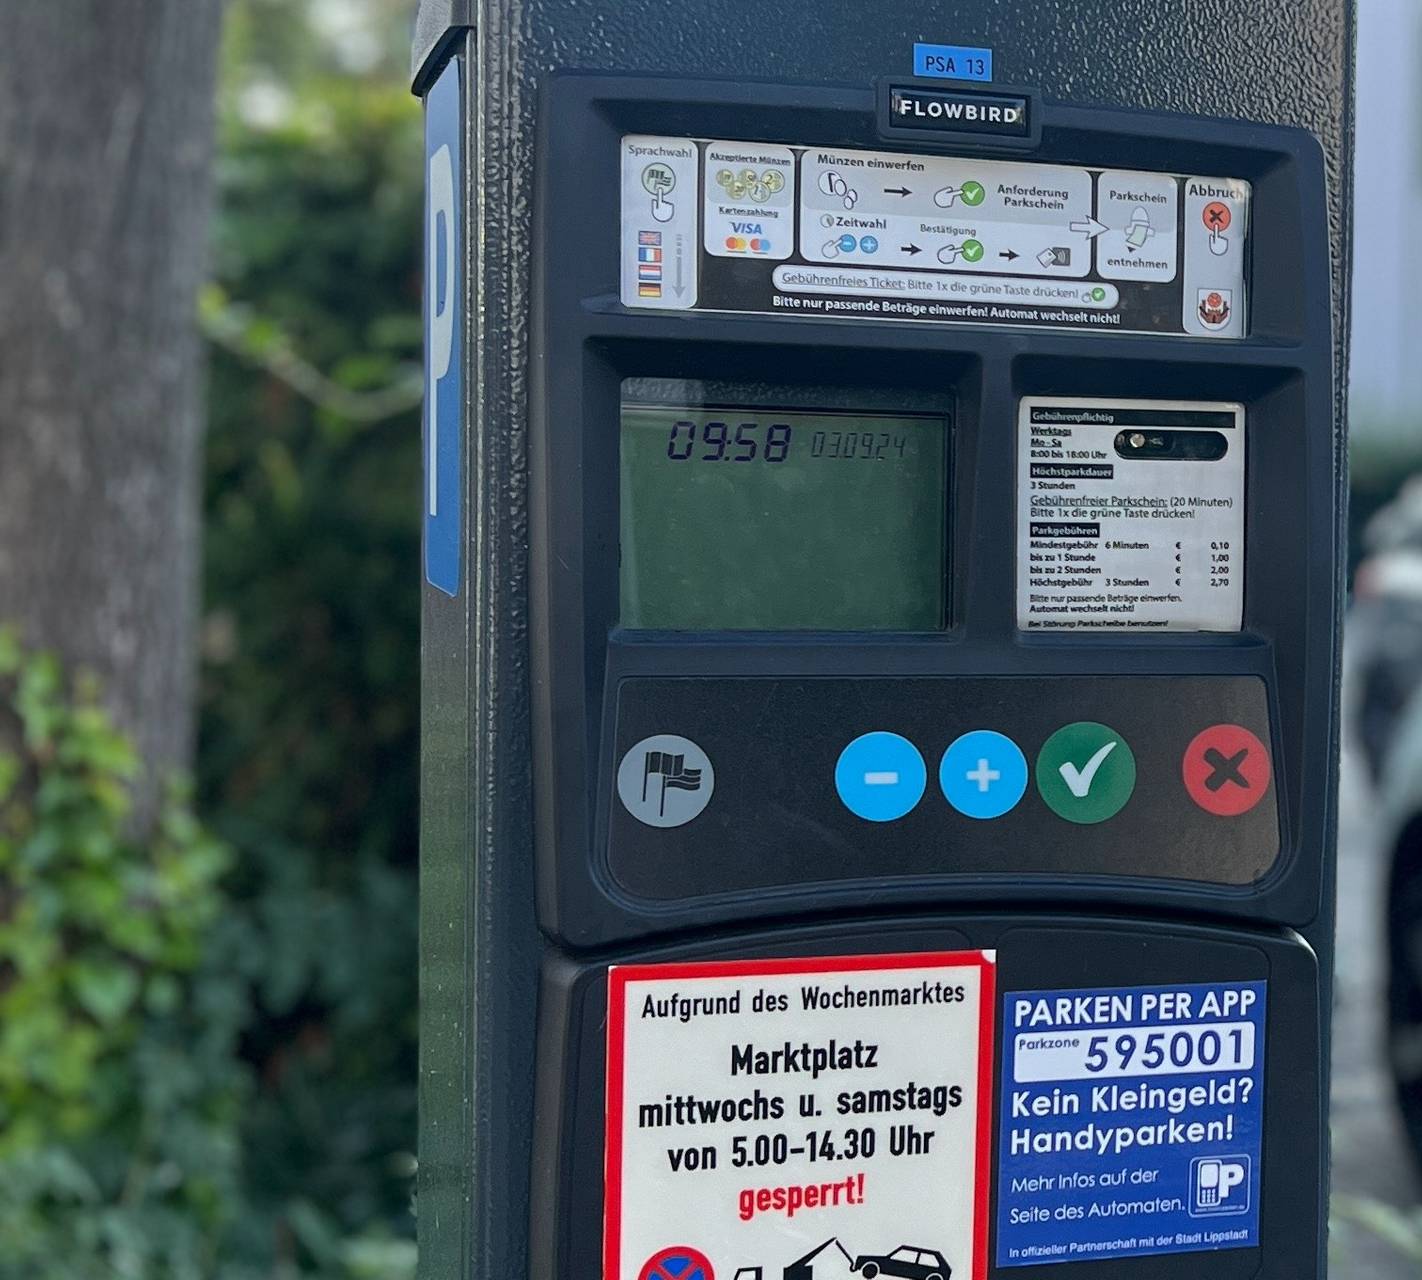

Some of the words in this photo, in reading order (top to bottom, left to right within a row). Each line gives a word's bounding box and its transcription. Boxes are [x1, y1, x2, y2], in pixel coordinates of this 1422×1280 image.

[925, 55, 955, 73] PSA
[966, 59, 984, 76] 13
[901, 99, 1018, 123] FLOWBIRD
[628, 144, 692, 159] Sprachwahl
[709, 152, 757, 164] Akzeptierte
[758, 156, 791, 166] Münzen
[817, 154, 864, 168] Münzen
[867, 158, 925, 172] einwerfen
[997, 184, 1069, 200] Anforderung
[1109, 190, 1167, 204] Parkschein
[1189, 184, 1244, 199] Abbruch
[1004, 196, 1065, 210] Parkschein
[718, 206, 779, 218] Kartenzahlung
[729, 221, 763, 235] VISA
[836, 216, 887, 230] Zeitwahl
[920, 223, 977, 237] Bestätigung
[1107, 258, 1168, 270] entnehmen
[782, 272, 868, 288] Gebührenfreies
[907, 279, 933, 291] Bitte
[936, 281, 948, 292] 1x
[950, 282, 968, 293] die
[969, 283, 1001, 296] grüne
[1003, 285, 1031, 296] Taste
[1032, 287, 1079, 299] drücken!
[773, 295, 801, 308] Bitte
[802, 298, 823, 309] nur
[825, 300, 880, 312] passende
[882, 302, 926, 316] Beträge
[928, 305, 988, 317] einwerfen!
[990, 307, 1039, 320] Automat
[1040, 310, 1088, 323] wechselt
[1090, 312, 1121, 325] nicht!
[430, 144, 454, 517] P
[1032, 410, 1114, 424] Gebührenpflichtig
[667, 420, 792, 462] 09:58
[1030, 438, 1045, 447] Mo
[1051, 439, 1062, 448] Sa
[1030, 449, 1050, 459] 8:00
[1051, 449, 1064, 459] bis
[1066, 450, 1090, 460] 18:00
[1090, 450, 1107, 460] Uhr
[1031, 466, 1113, 478] Höchstparkdauer
[1030, 482, 1036, 490] 3
[1038, 481, 1076, 491] Stunden
[1030, 495, 1109, 507] Gebührenfreier
[1110, 495, 1168, 508] Parkschein:
[1169, 497, 1187, 508] (20
[1188, 496, 1233, 508] Minuten)
[1030, 507, 1054, 518] Bitte
[1057, 508, 1069, 518] 1x
[1071, 508, 1088, 518] die
[1090, 508, 1121, 520] grüne
[1123, 508, 1150, 519] Taste
[1151, 508, 1195, 519] drücken!
[1031, 525, 1098, 536] Parkgebühren
[1030, 540, 1098, 551] Mindestgebühr
[1105, 541, 1111, 550] 6
[1112, 541, 1150, 550] Minuten
[1210, 541, 1230, 551] 0,10
[1030, 553, 1043, 562] bis
[1063, 553, 1096, 562] Stunde
[1030, 565, 1043, 575] bis
[1044, 567, 1056, 575] zu
[1057, 566, 1063, 574] 2
[1064, 565, 1101, 575] Stunden
[1030, 578, 1093, 589] Höchstgebühr
[1105, 579, 1111, 587] 3
[1112, 578, 1150, 587] Stunden
[1030, 594, 1050, 603] Bitte
[1066, 595, 1106, 605] passende
[1107, 594, 1139, 605] Beträge
[1029, 604, 1069, 613] Automat
[1070, 604, 1108, 613] wechselt
[1109, 604, 1135, 613] nicht!
[641, 990, 741, 1023] Aufgrund
[752, 988, 789, 1013] des
[801, 981, 965, 1011] Wochenmarktes
[1014, 995, 1132, 1027] PARKEN
[1141, 992, 1192, 1021] PER
[1198, 989, 1256, 1018] APP
[1018, 1038, 1080, 1051] Parkzone
[1084, 1029, 1242, 1072] 595001
[731, 1038, 878, 1079] Marktplatz
[639, 1088, 785, 1128] mittwochs
[799, 1092, 822, 1117] u.
[837, 1081, 962, 1117] samstags
[1012, 1088, 1080, 1118] Kein
[1091, 1077, 1254, 1114] Kleingeld?
[1011, 1114, 1233, 1155] Handyparken!
[668, 1144, 717, 1172] von
[889, 1124, 936, 1156] Uhr
[1011, 1175, 1056, 1193] Mehr
[1058, 1171, 1096, 1189] Infos
[1099, 1168, 1128, 1187] auf
[1130, 1167, 1160, 1185] der
[739, 1173, 865, 1221] gesperrt!
[1010, 1205, 1050, 1224] Seite
[1054, 1202, 1084, 1220] des
[1087, 1197, 1186, 1219] Automaten.
[1009, 1248, 1019, 1258] In
[1021, 1245, 1067, 1258] offizieller
[1069, 1238, 1137, 1253] Partnerschaft
[1139, 1236, 1155, 1247] mit
[1156, 1235, 1174, 1246] der
[1175, 1232, 1201, 1244] Stadt
[1204, 1229, 1249, 1244] Lippstadt
